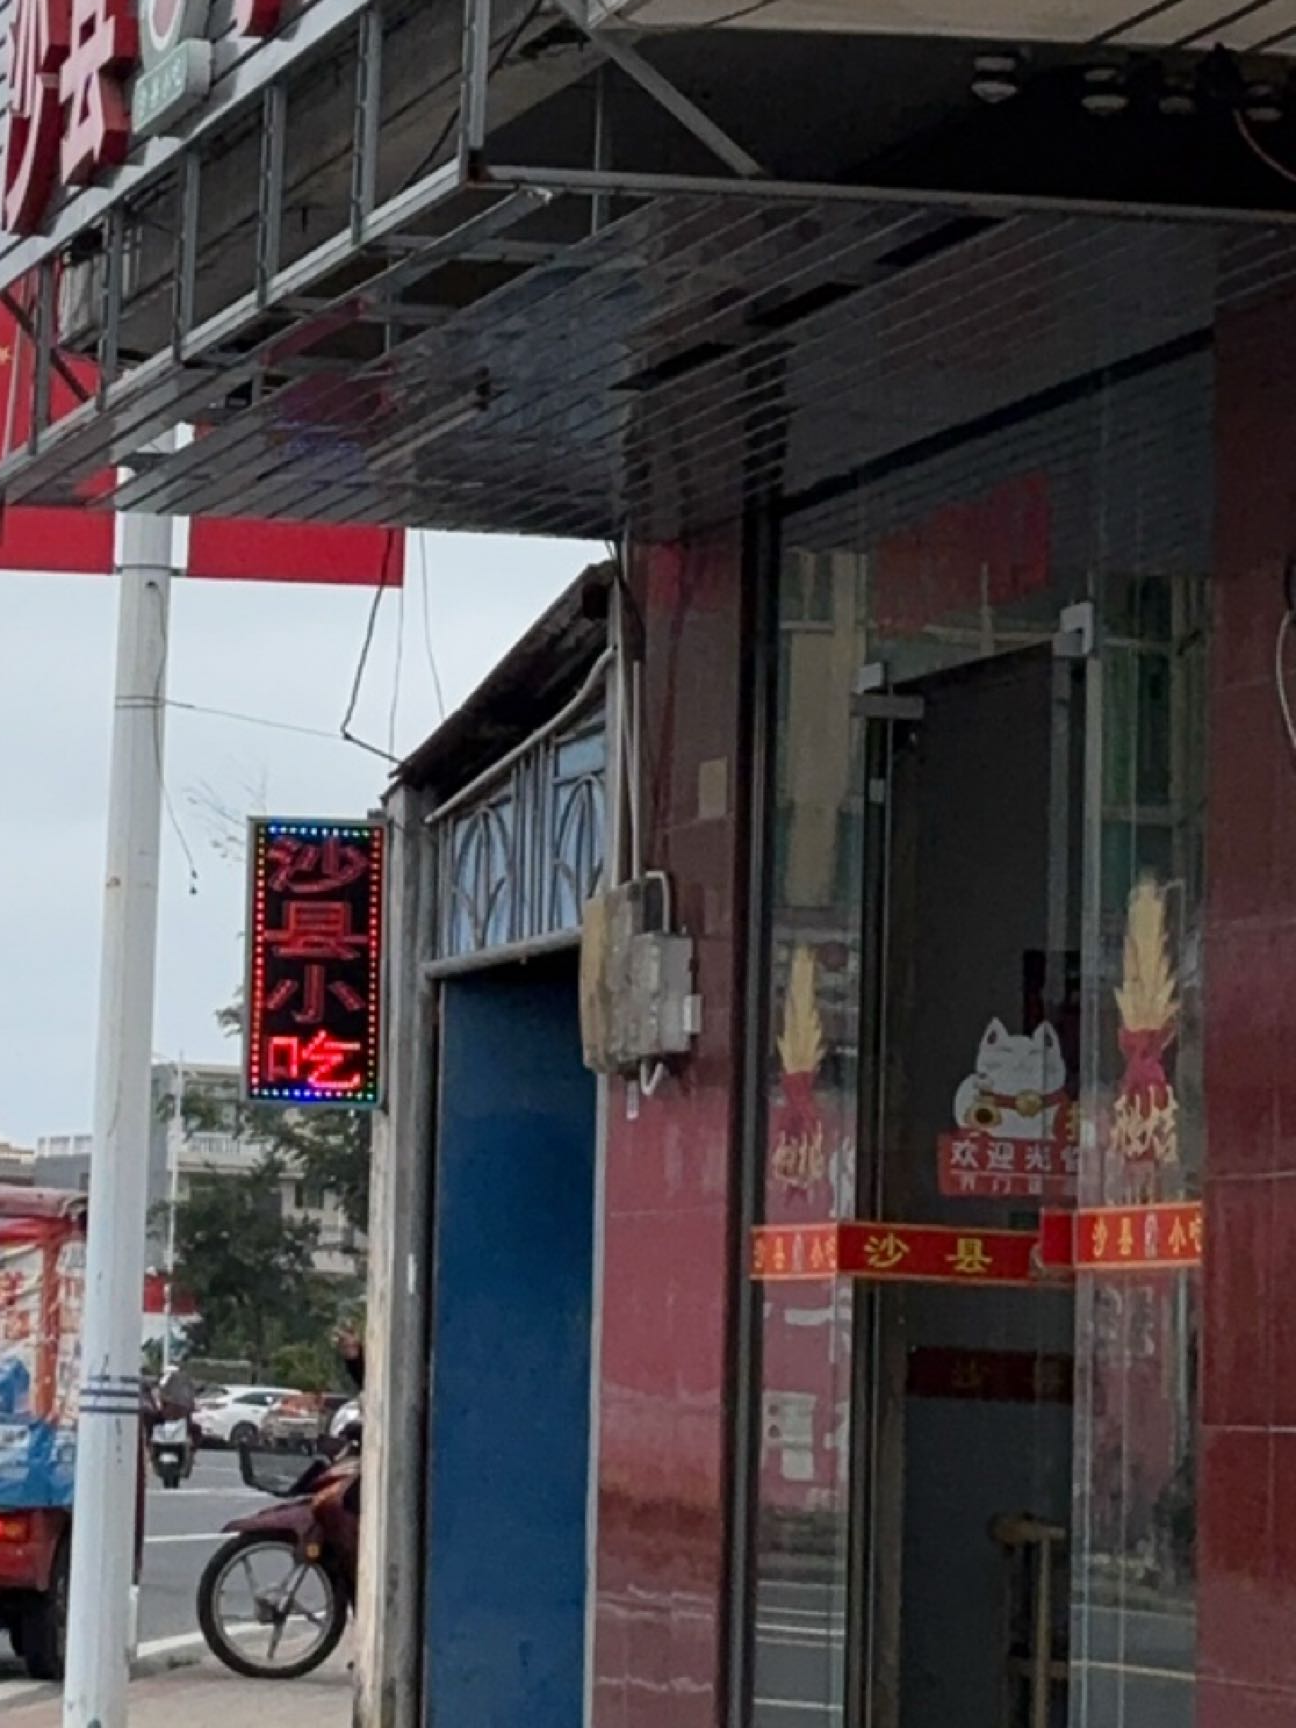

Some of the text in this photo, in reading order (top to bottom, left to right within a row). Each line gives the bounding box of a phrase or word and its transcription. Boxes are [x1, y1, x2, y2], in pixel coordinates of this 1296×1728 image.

[265, 834, 369, 1090] 沙县小吃
[864, 1232, 993, 1273] 沙县
